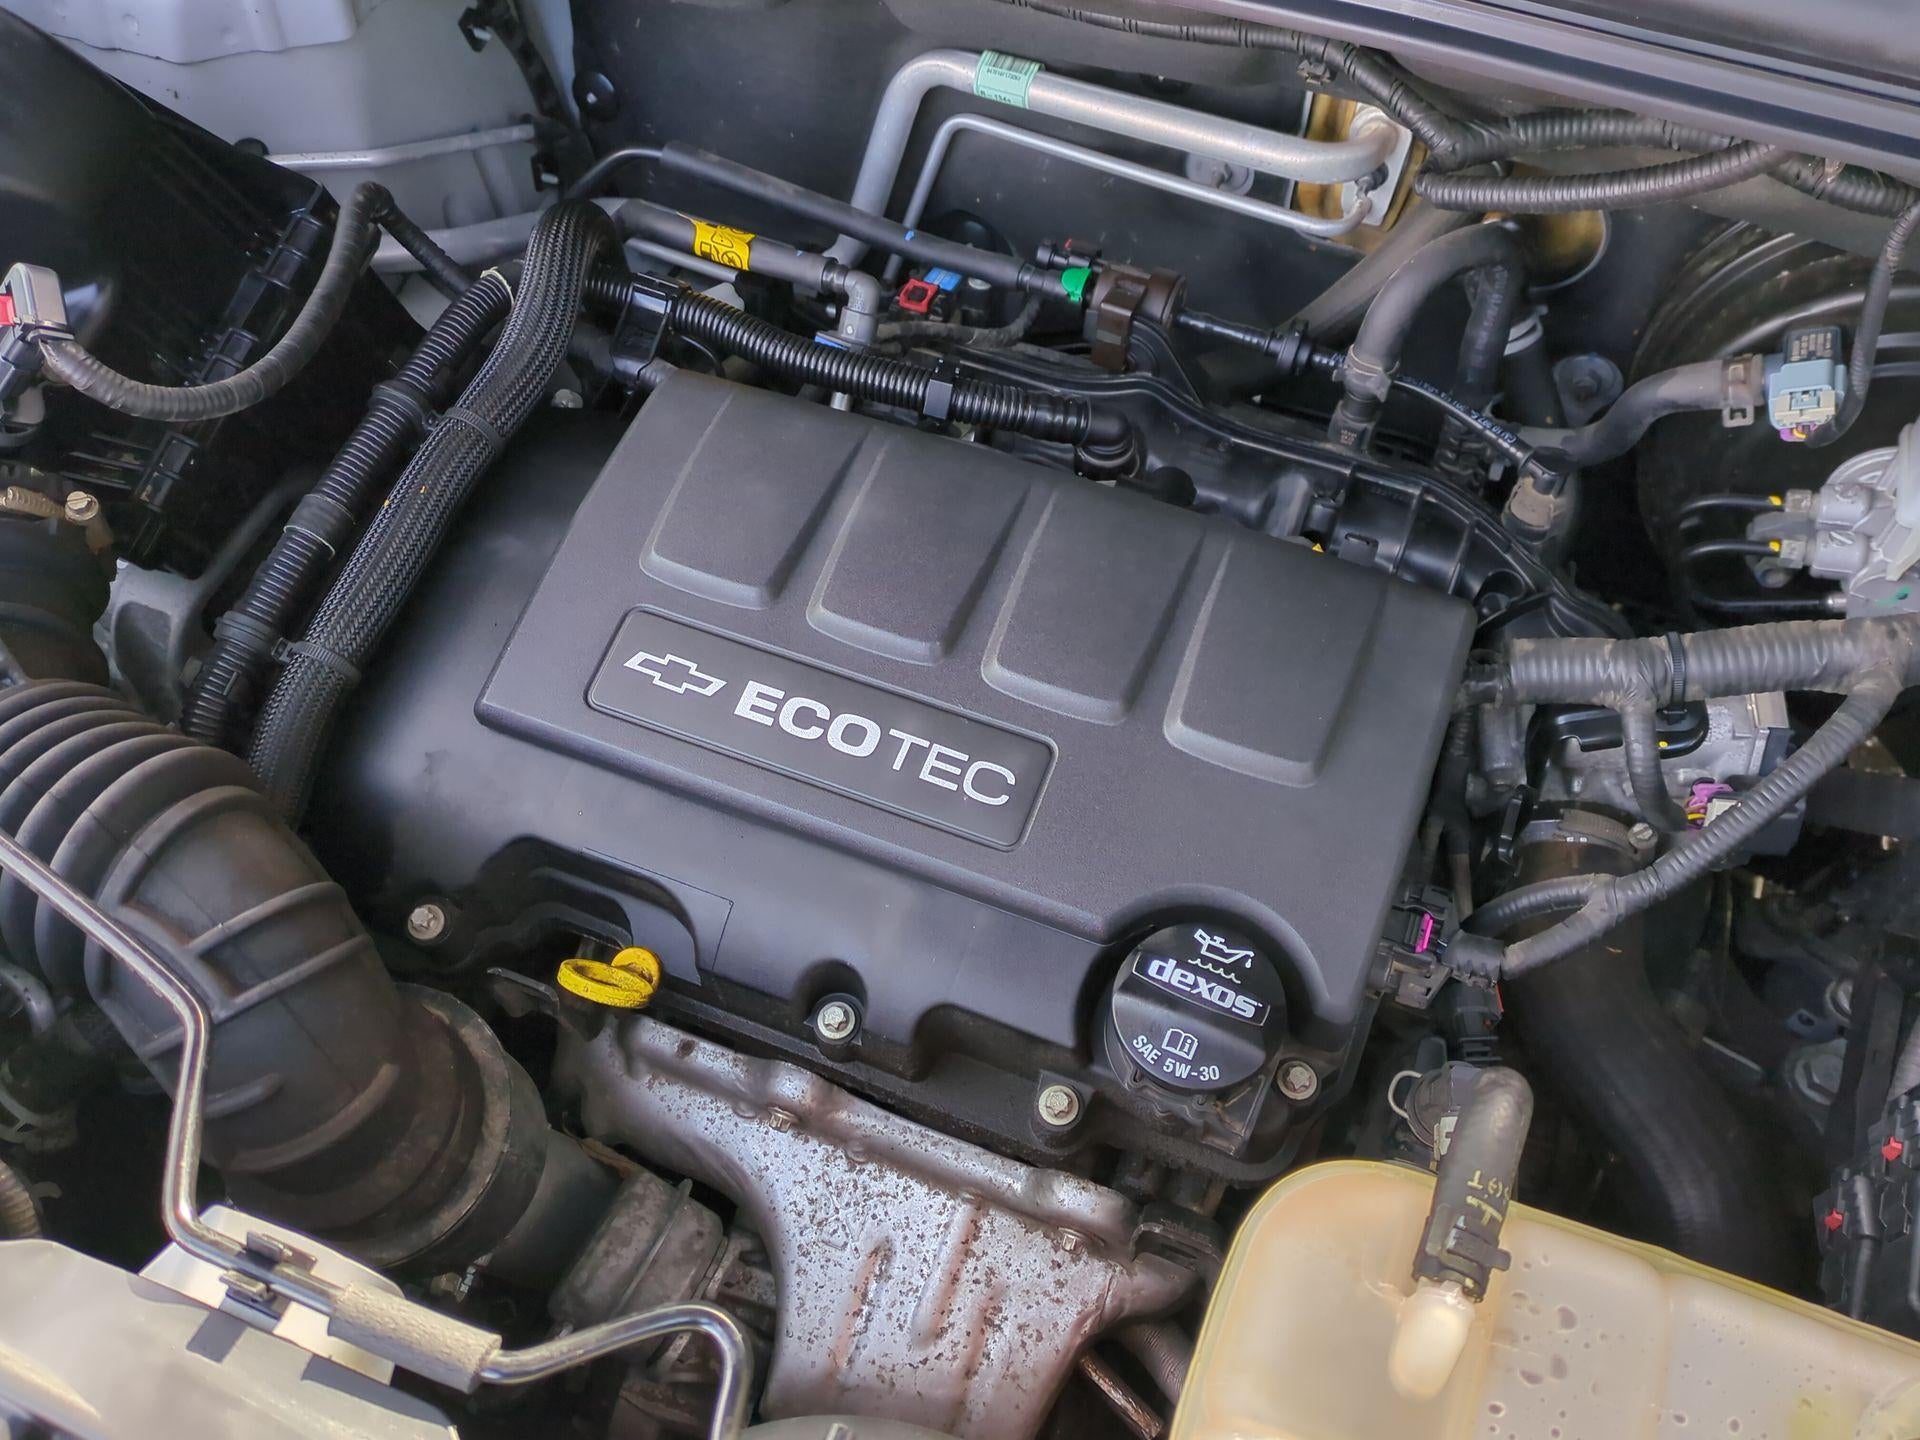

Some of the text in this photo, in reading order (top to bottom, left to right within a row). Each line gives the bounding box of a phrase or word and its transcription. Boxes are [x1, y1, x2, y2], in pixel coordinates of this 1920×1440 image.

[734, 680, 1017, 806] ECOTEC
[1147, 958, 1258, 1018] dexos
[1132, 1035, 1220, 1081] SAE 5W-30
